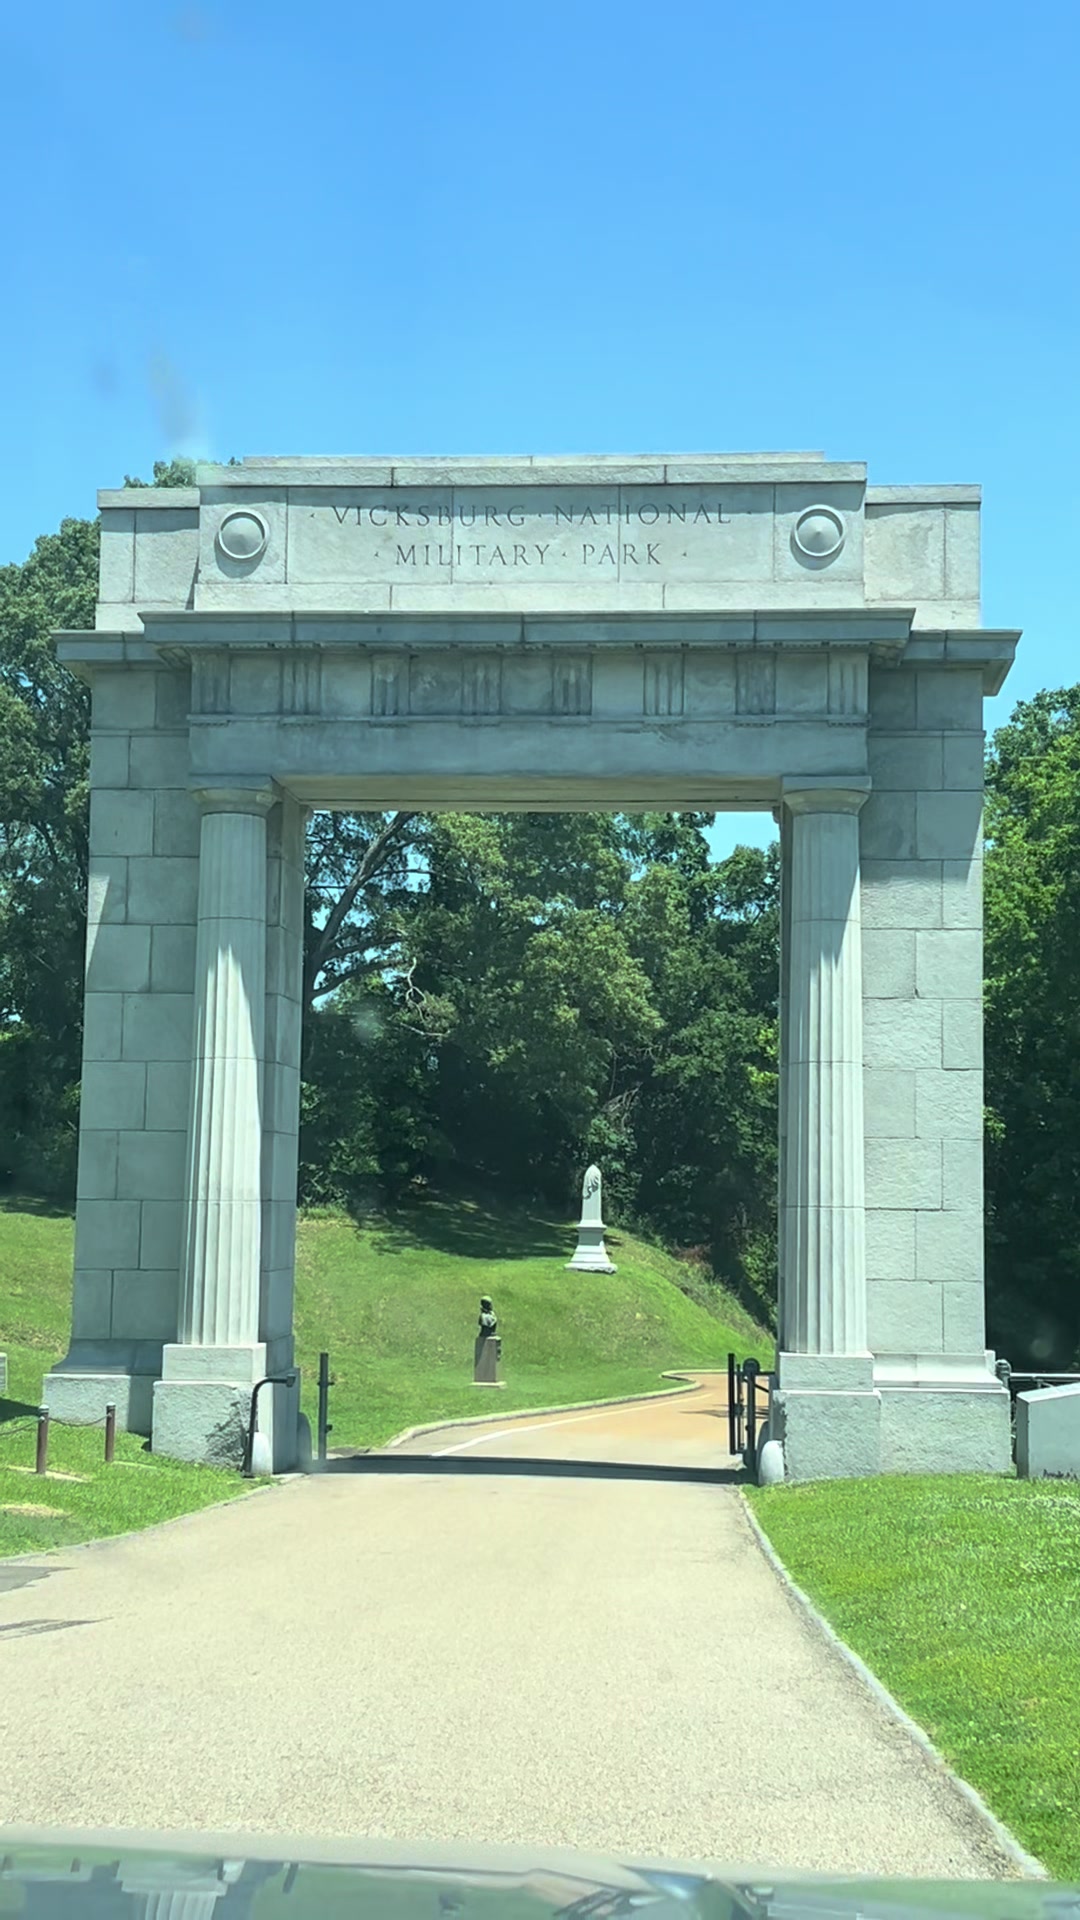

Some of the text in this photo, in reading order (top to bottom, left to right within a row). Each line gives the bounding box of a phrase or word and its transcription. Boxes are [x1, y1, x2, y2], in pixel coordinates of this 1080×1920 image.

[331, 503, 731, 527] VICKSBURG NATIONAL
[395, 542, 662, 566] MILITARY PARK
